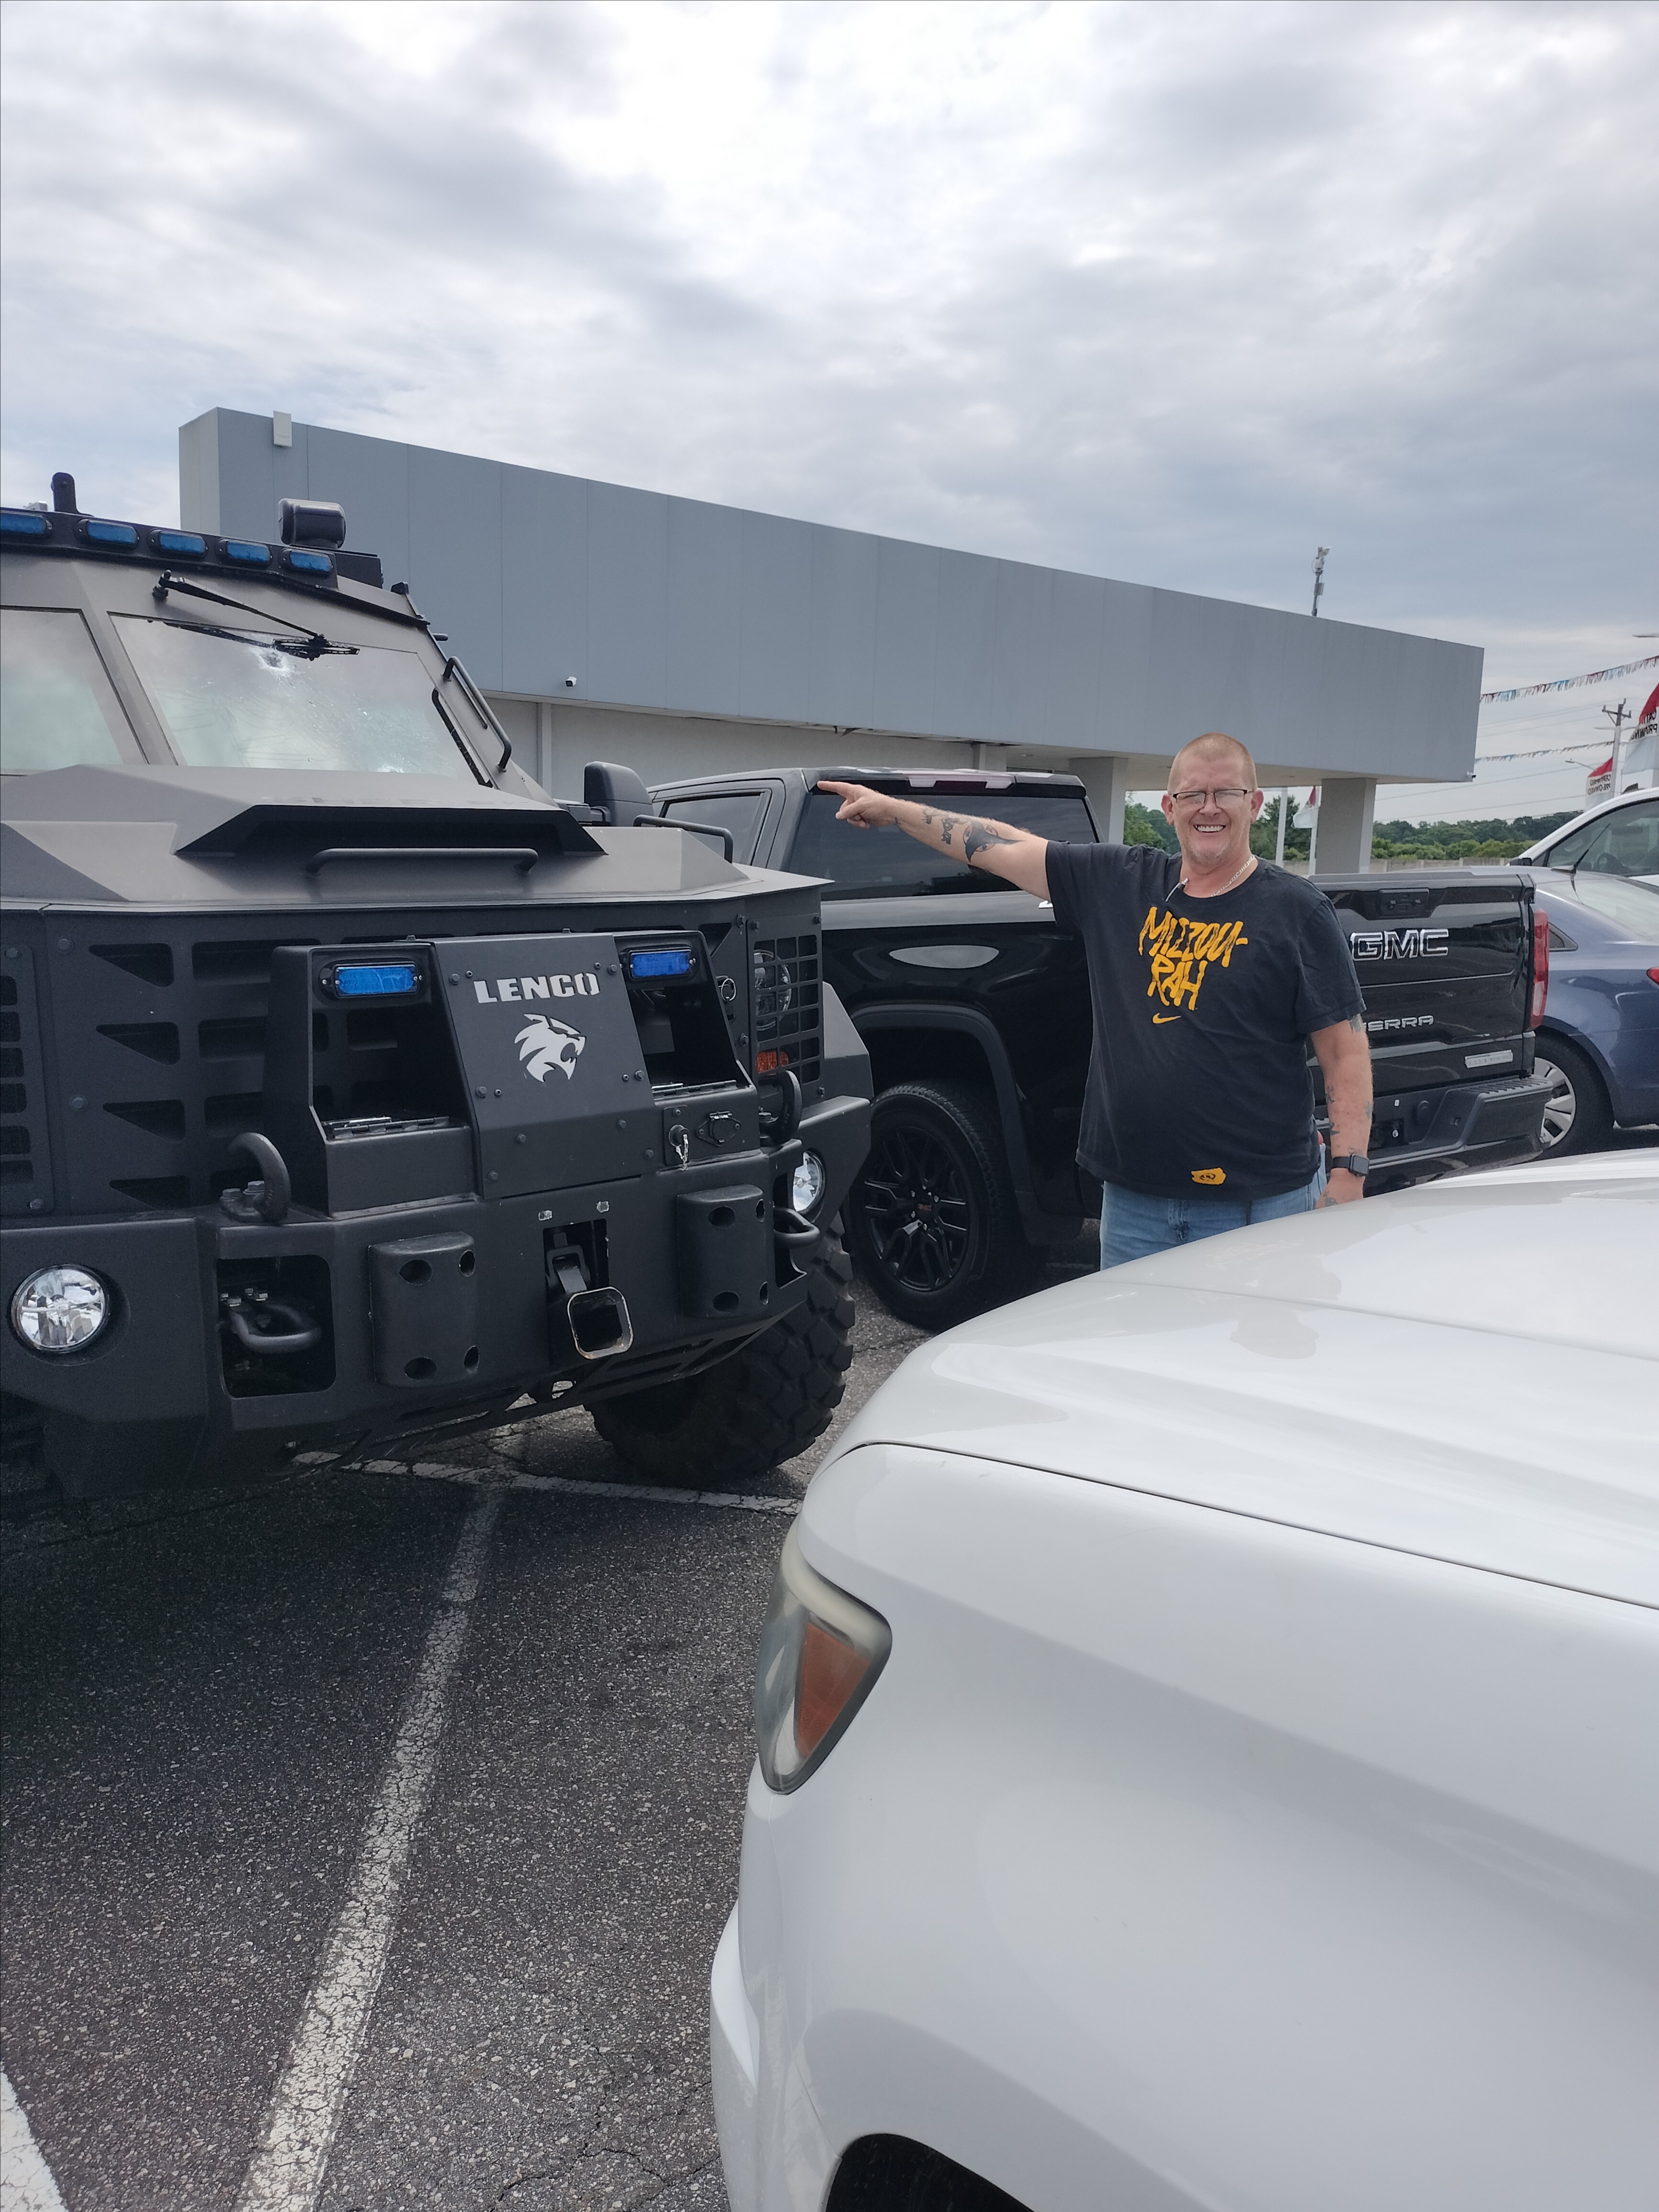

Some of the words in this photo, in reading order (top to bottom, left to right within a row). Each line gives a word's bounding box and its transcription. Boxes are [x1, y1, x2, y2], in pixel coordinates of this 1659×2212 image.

[1350, 929, 1449, 961] GMC
[474, 973, 601, 1003] LENCO
[1148, 954, 1208, 1011] RAH
